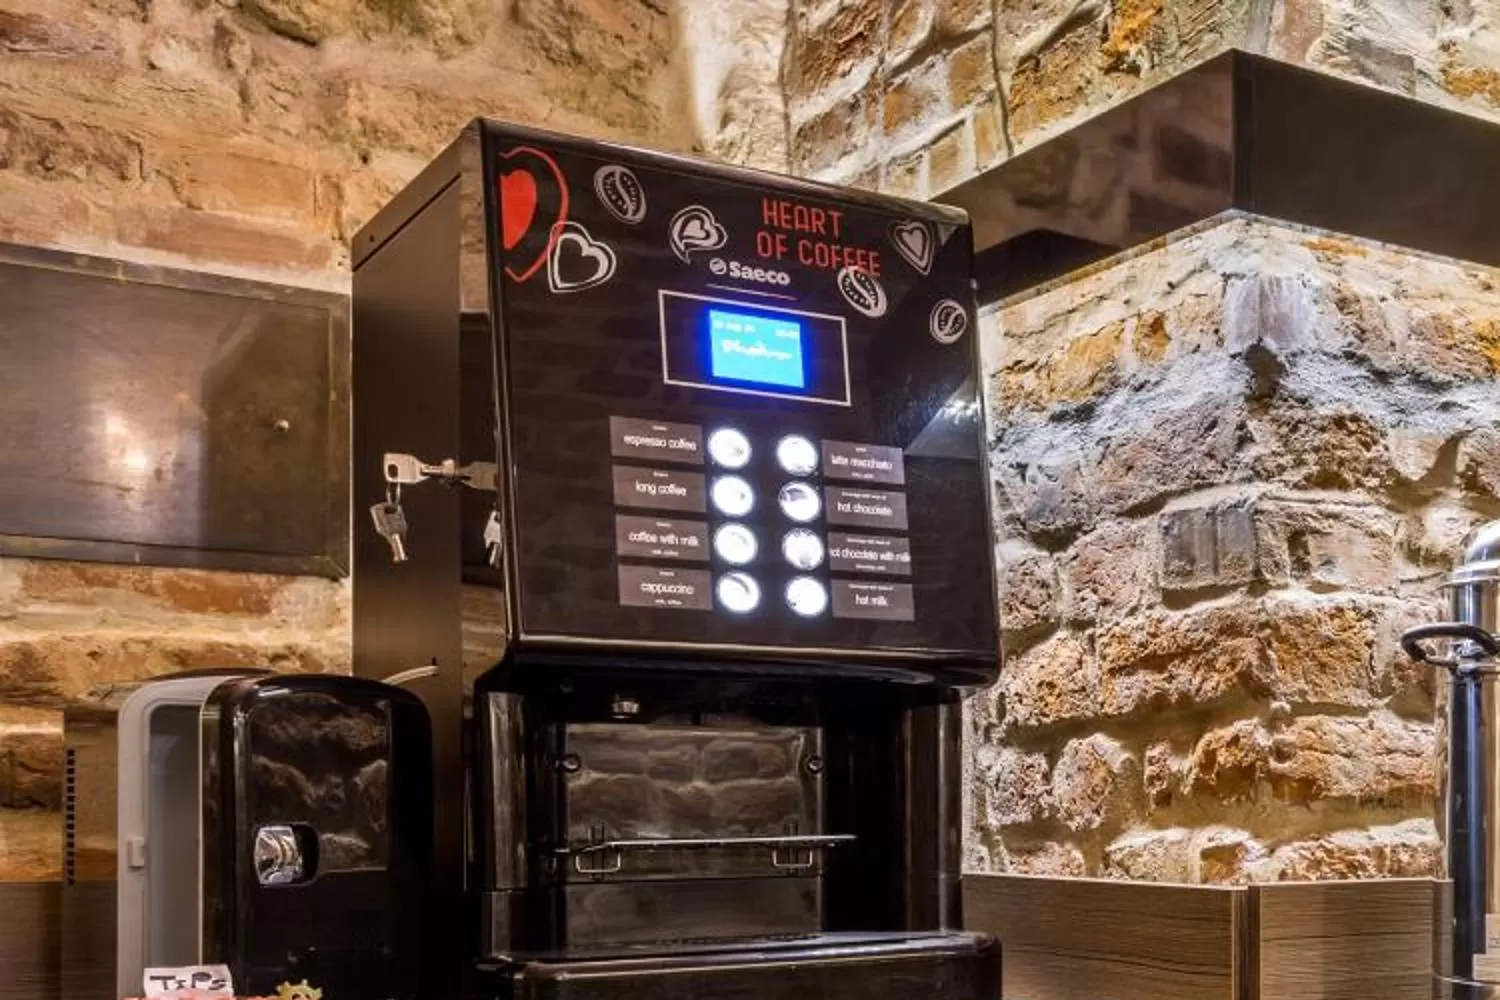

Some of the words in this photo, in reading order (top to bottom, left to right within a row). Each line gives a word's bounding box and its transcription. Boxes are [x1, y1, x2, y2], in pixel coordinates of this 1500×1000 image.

[762, 197, 844, 237] HEART
[756, 231, 788, 261] OF
[799, 239, 881, 278] COFFEE
[728, 260, 792, 287] Saeco
[668, 438, 697, 451] coffee
[635, 480, 657, 496] long
[658, 484, 687, 496] coffee
[628, 531, 658, 544] coffee
